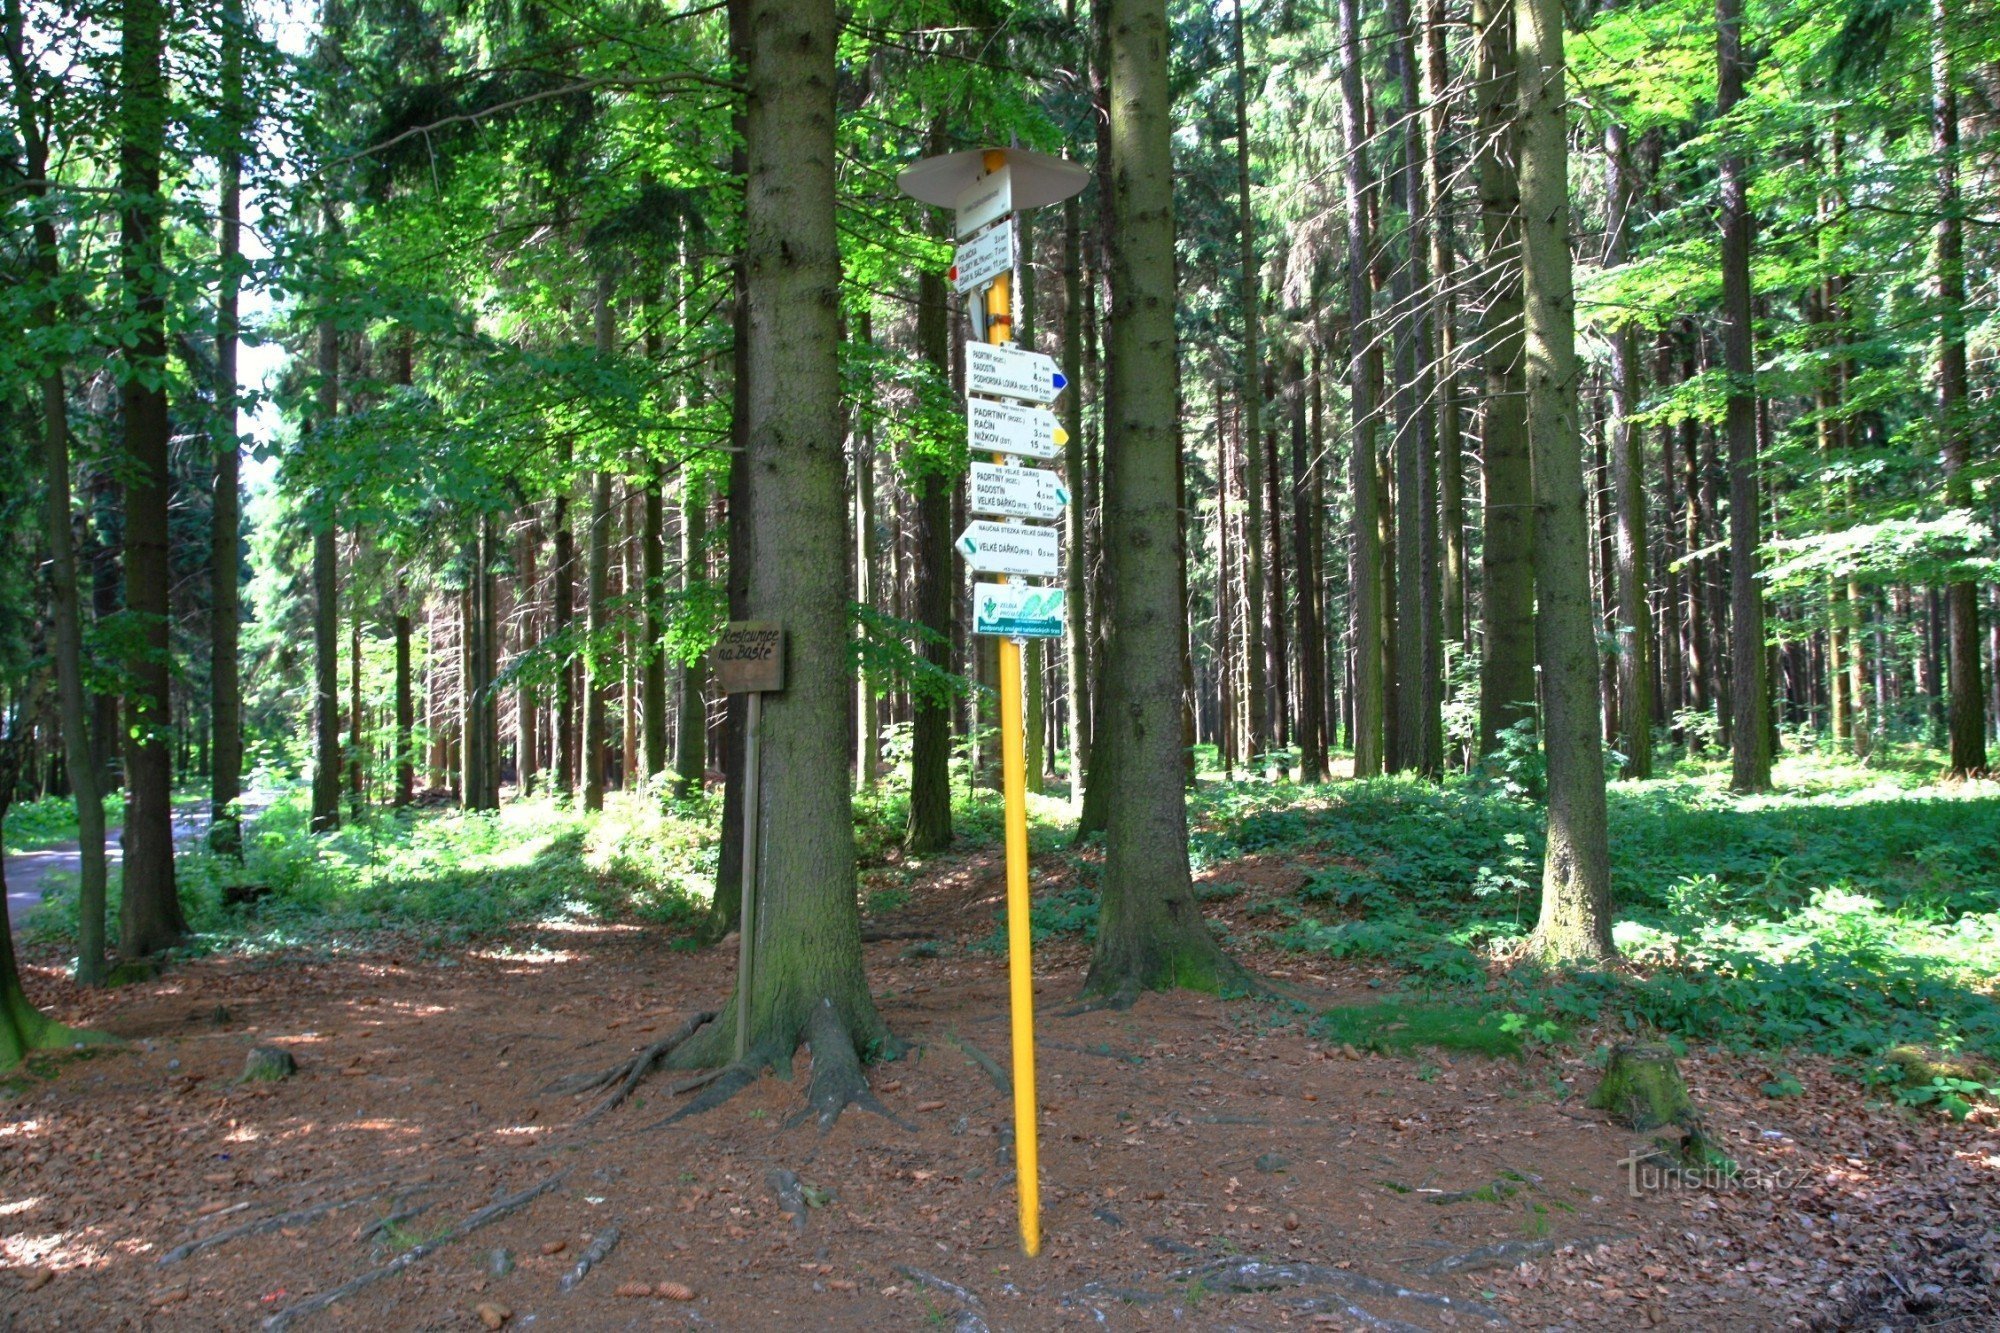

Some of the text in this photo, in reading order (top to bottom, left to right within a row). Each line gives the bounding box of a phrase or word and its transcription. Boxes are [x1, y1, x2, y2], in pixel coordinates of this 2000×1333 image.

[1033, 362, 1037, 370] 1
[974, 408, 1006, 420] PADRTINY
[1034, 418, 1038, 426] 1
[1030, 440, 1038, 448] 15
[976, 472, 1004, 482] PADRTINY
[1001, 527, 1020, 535] STEZKA
[979, 542, 998, 552] VELKÉ
